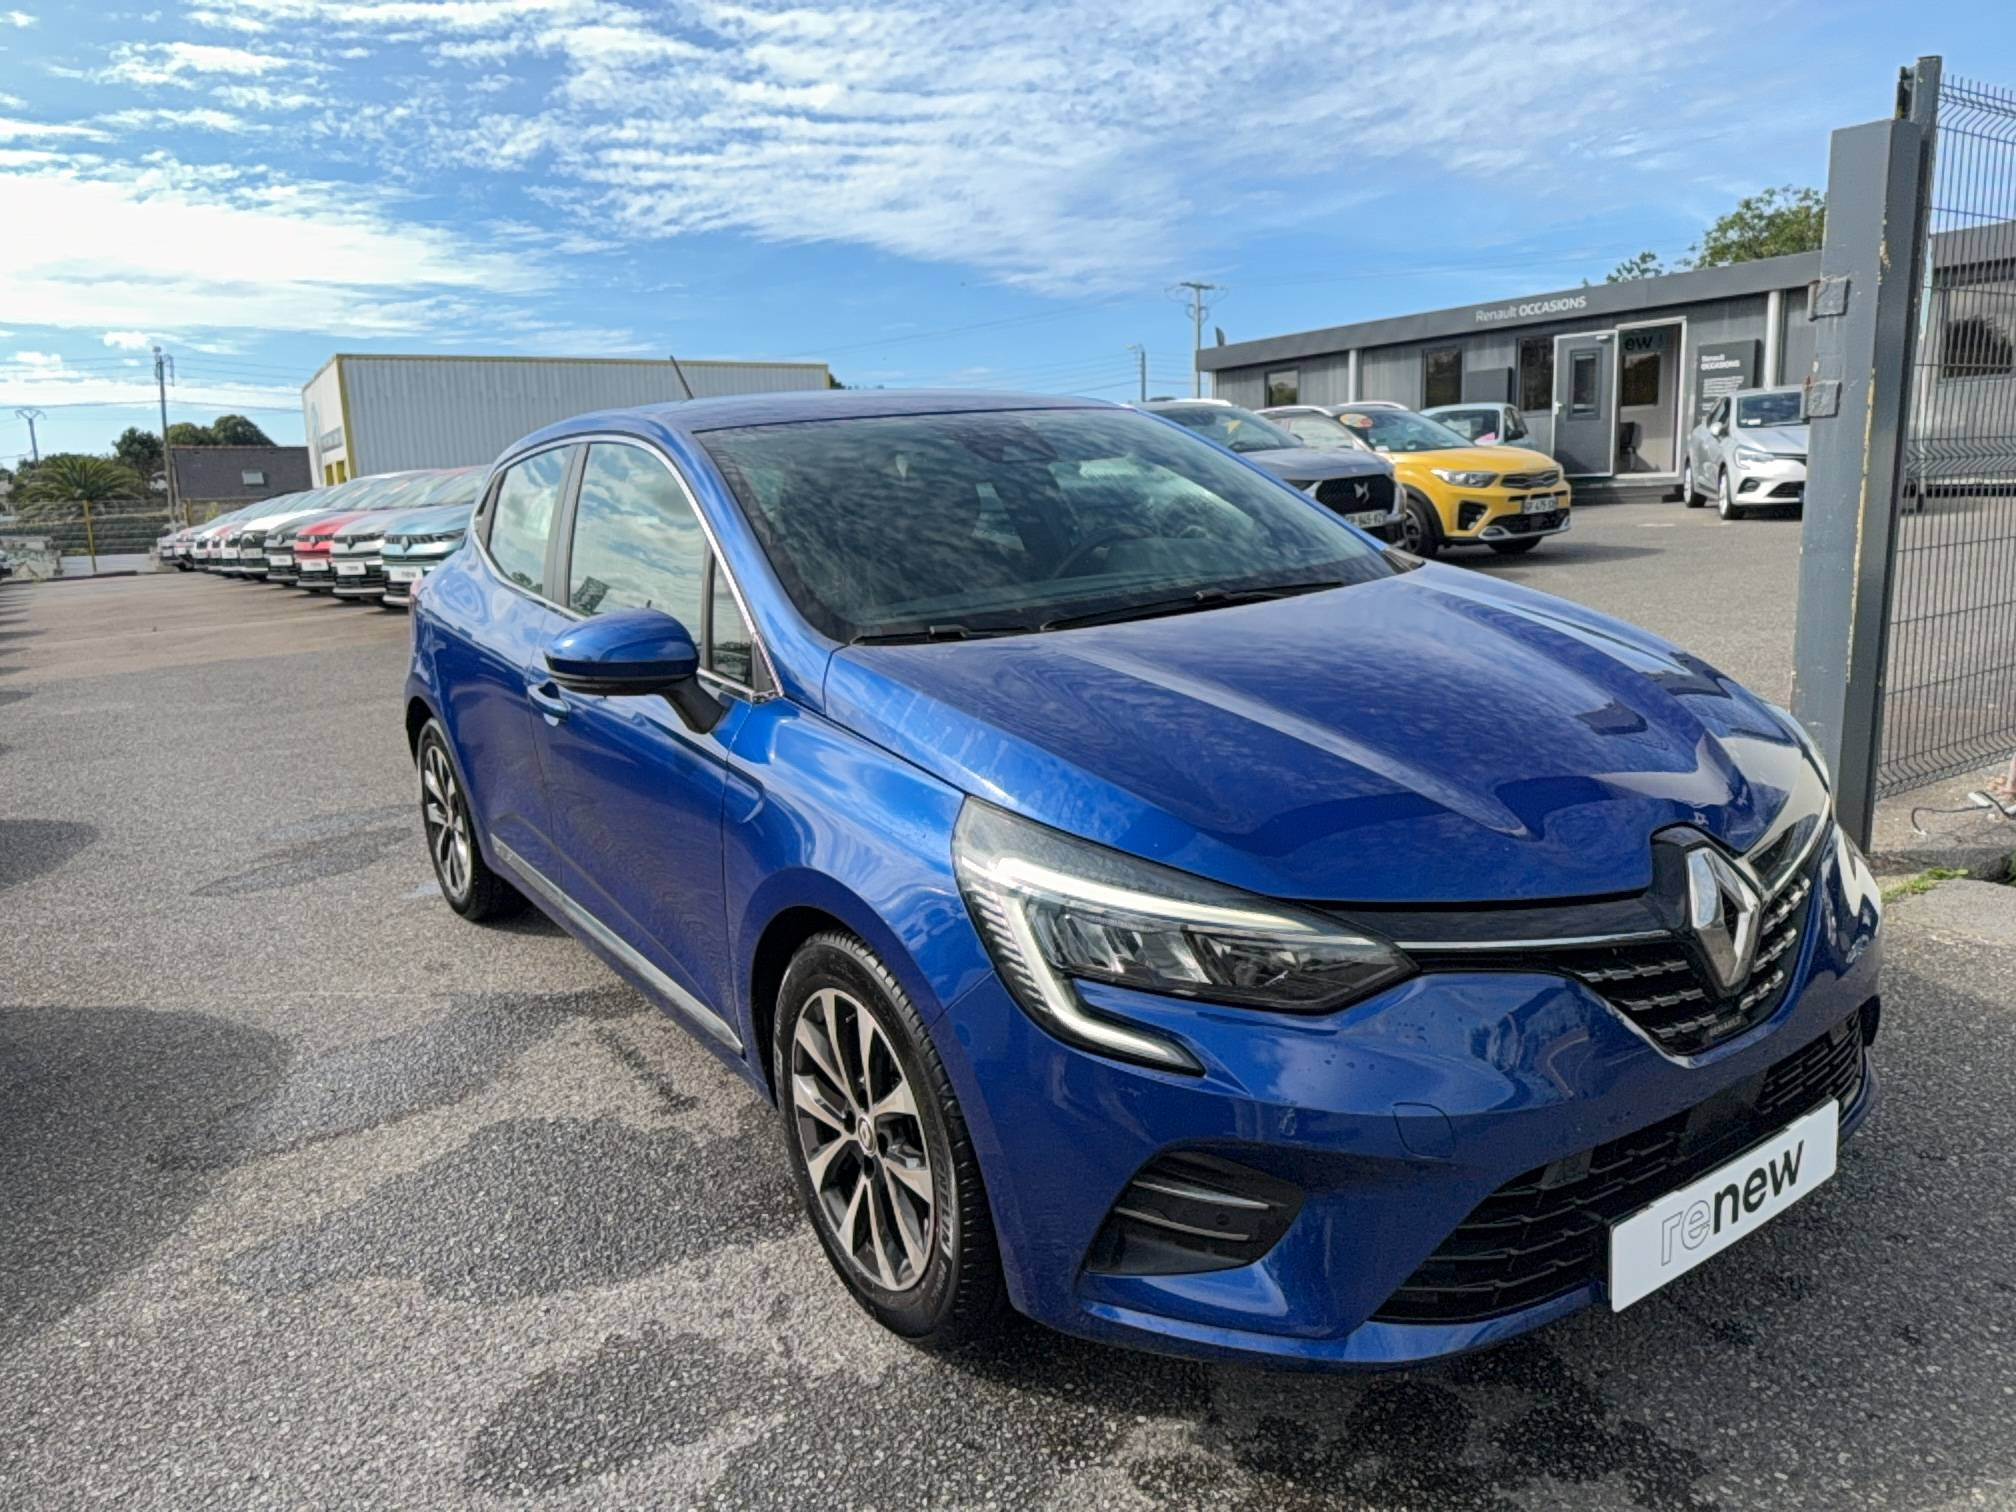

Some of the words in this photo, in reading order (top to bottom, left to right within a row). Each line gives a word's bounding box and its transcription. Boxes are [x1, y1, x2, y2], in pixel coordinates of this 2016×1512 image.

[1475, 306, 1517, 322] Renault
[1518, 296, 1587, 317] OCCASIONS
[1661, 1140, 1804, 1267] renew
